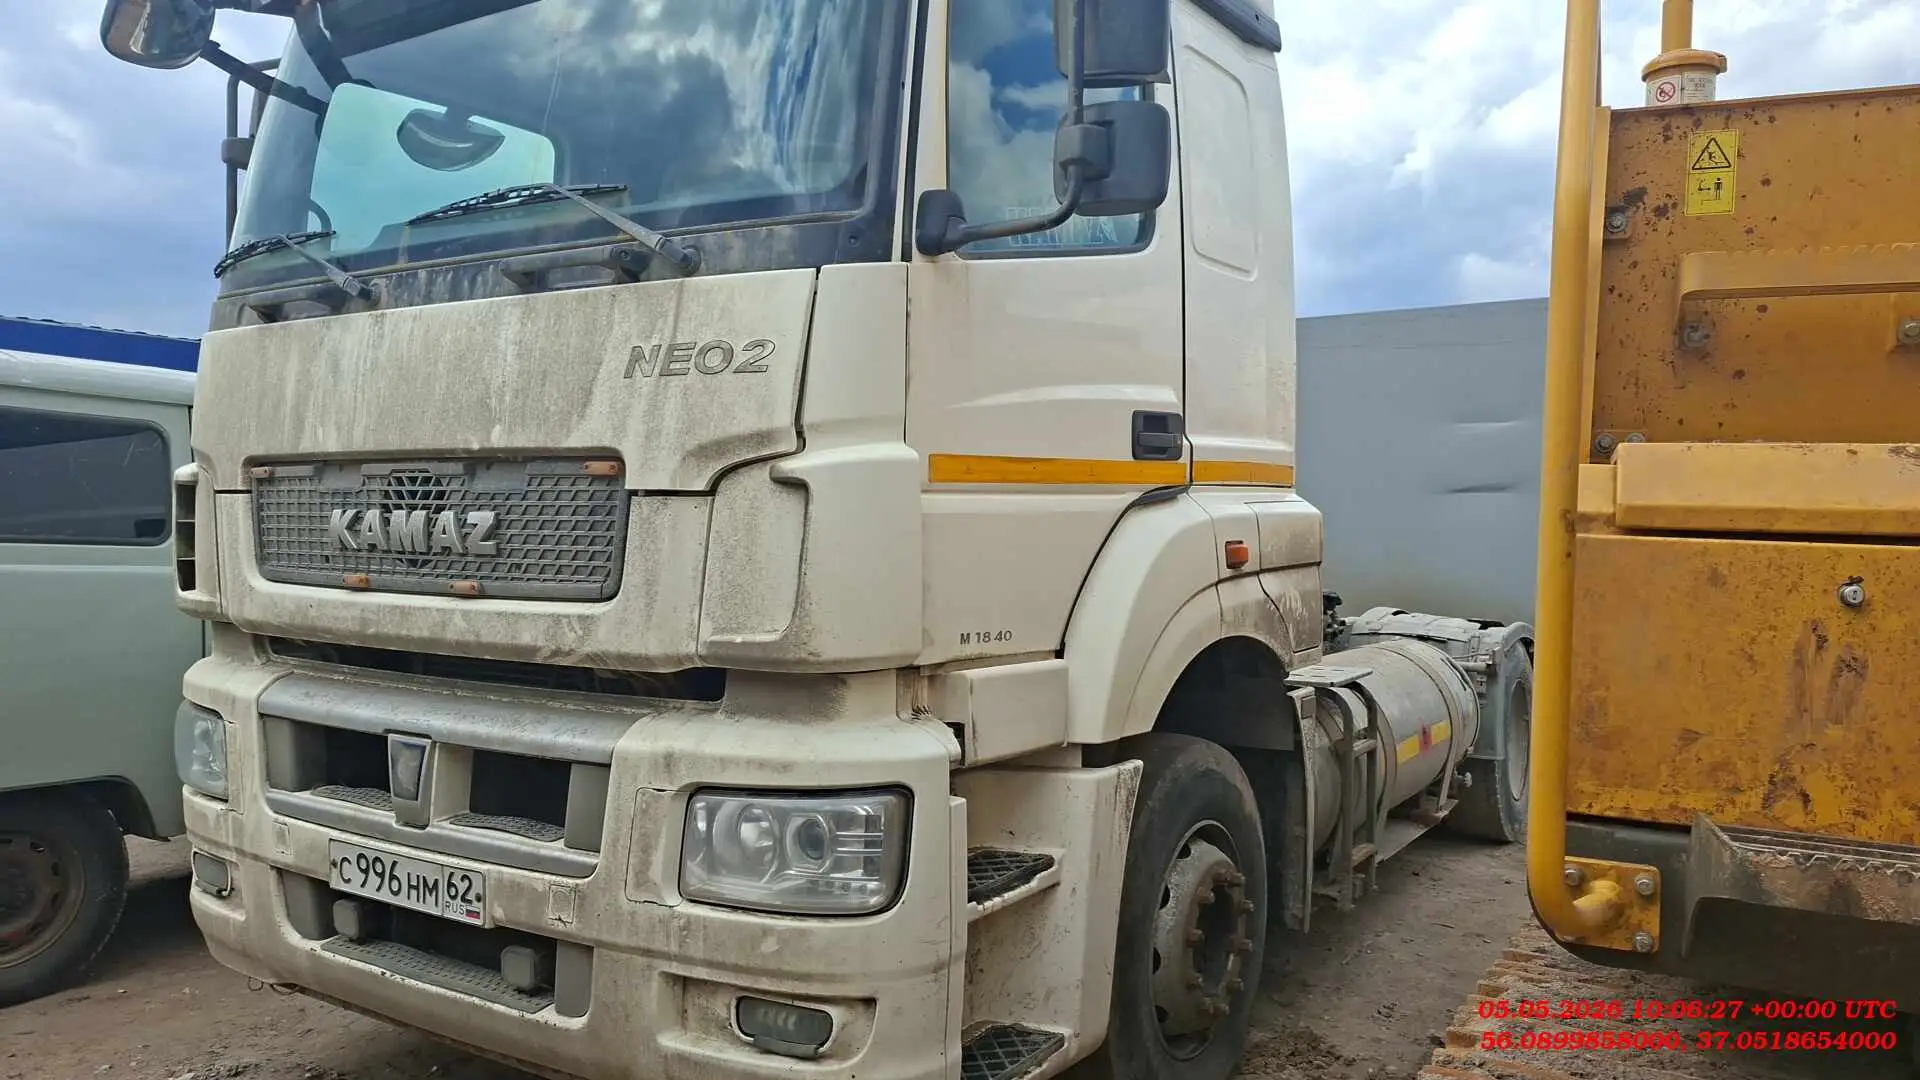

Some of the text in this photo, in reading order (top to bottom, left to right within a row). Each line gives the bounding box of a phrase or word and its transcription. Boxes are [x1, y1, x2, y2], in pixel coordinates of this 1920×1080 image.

[623, 338, 776, 379] NEO2
[329, 508, 498, 556] KAMAZ
[960, 632, 971, 645] M
[446, 871, 473, 905] 62
[444, 900, 466, 916] RUS
